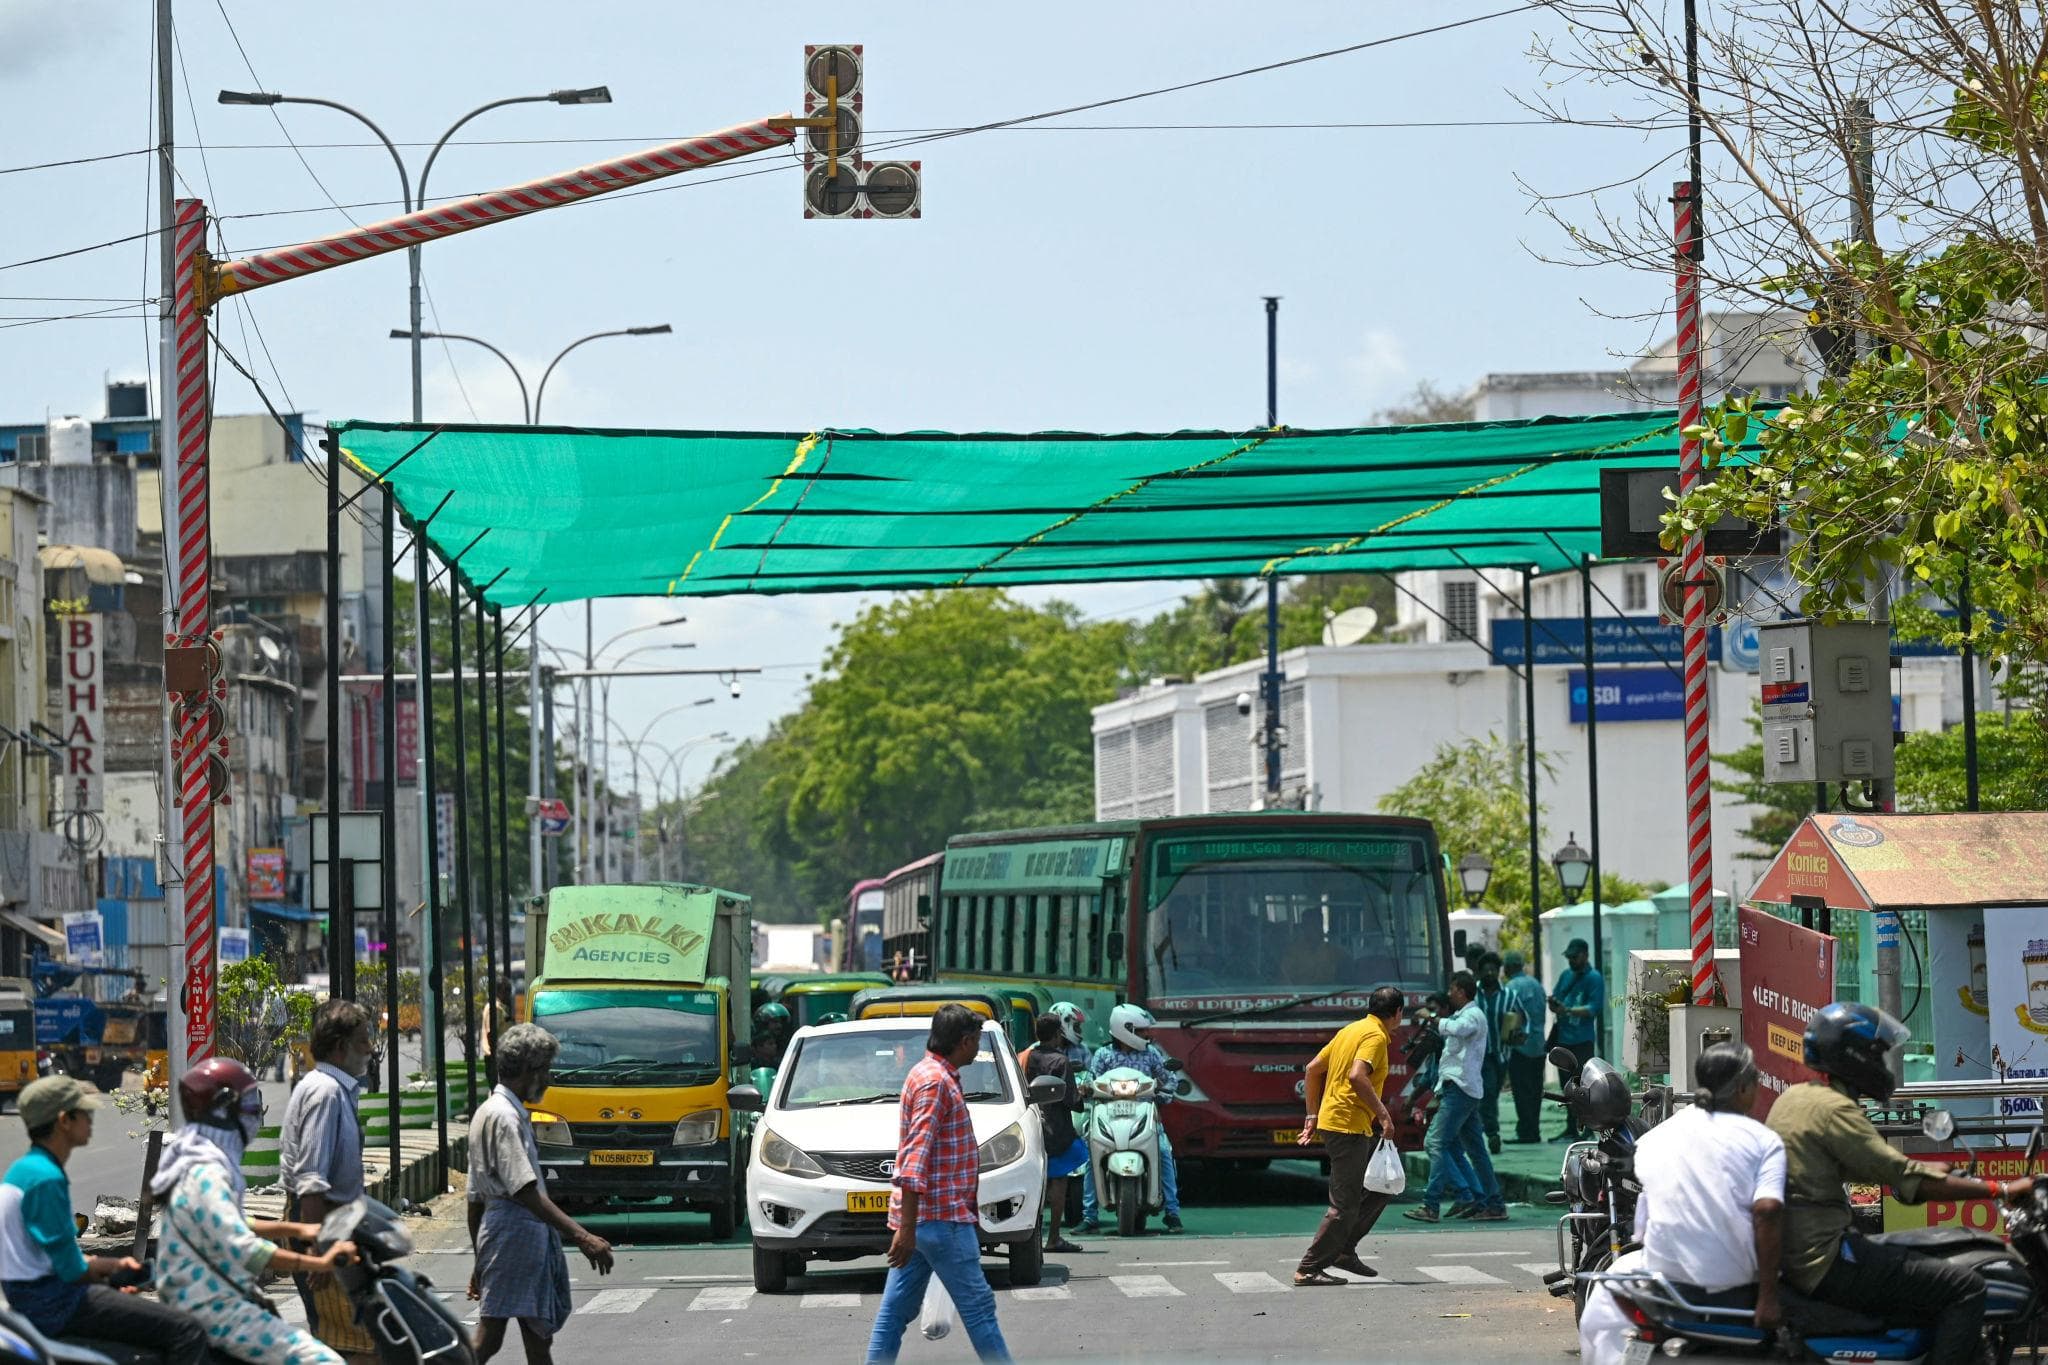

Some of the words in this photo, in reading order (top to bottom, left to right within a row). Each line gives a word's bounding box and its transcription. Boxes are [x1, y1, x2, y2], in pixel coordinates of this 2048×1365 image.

[67, 620, 97, 806] BUHARI
[1787, 852, 1829, 873] Konika
[1787, 873, 1829, 889] JEWELLERY
[582, 913, 705, 957] KALKI
[572, 947, 671, 965] AGENCIES
[192, 966, 203, 1022] YAMINI
[1758, 986, 1780, 1012] LEFT
[1781, 994, 1790, 1016] IS
[1770, 1031, 1786, 1051] KEEP
[1787, 1037, 1801, 1056] LEFT
[1253, 1065, 1295, 1073] ASHOK
[852, 1197, 866, 1208] TN
[870, 1196, 882, 1207] 10
